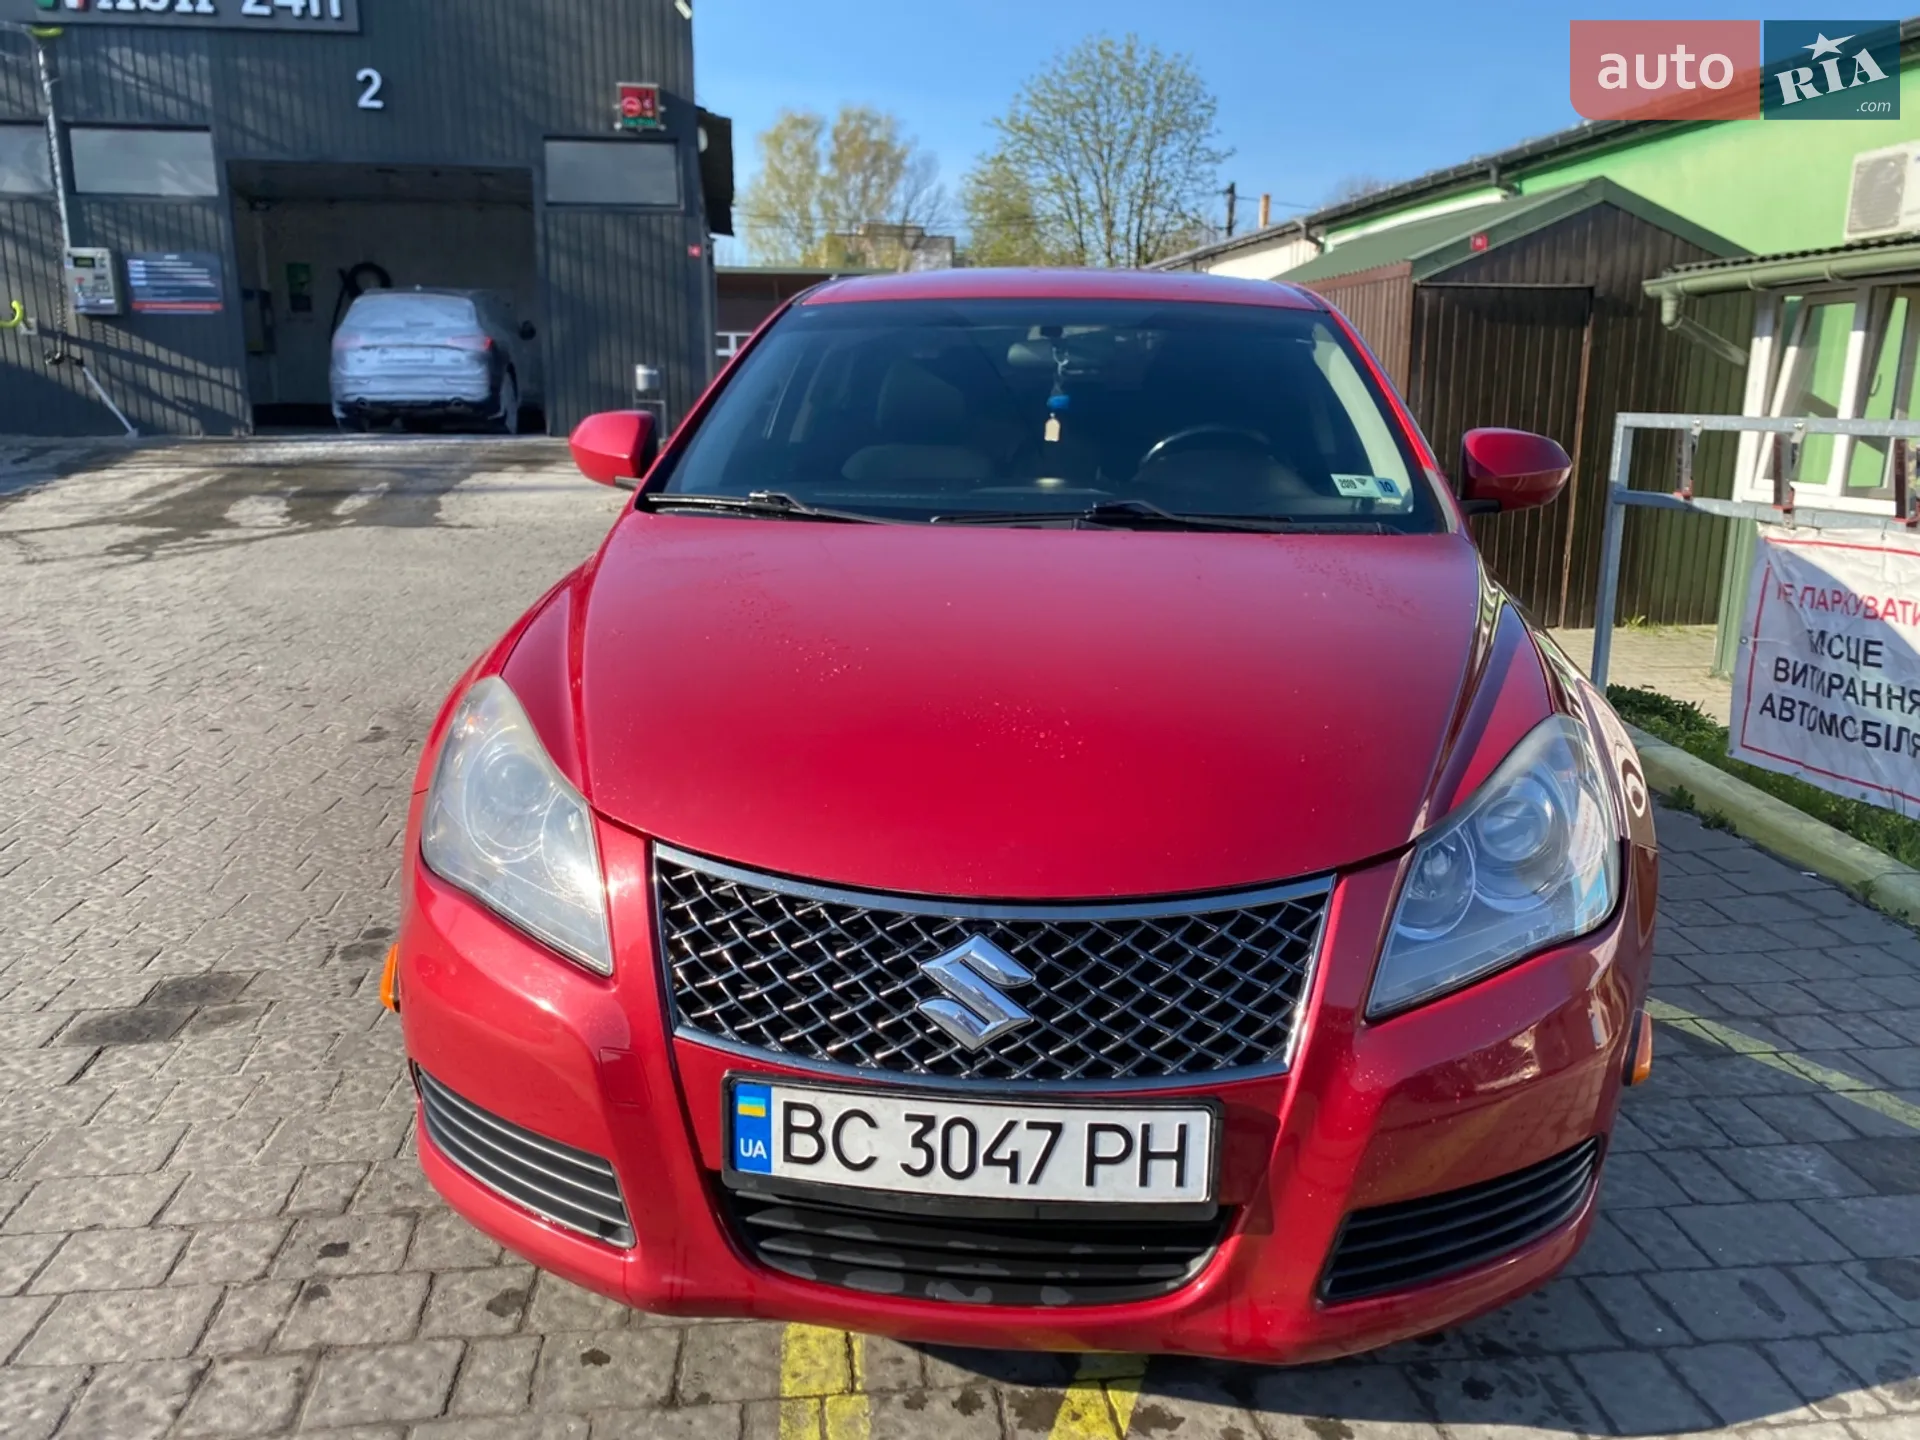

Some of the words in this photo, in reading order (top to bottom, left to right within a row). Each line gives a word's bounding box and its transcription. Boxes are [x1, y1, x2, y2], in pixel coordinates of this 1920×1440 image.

[356, 67, 384, 109] 2
[740, 1137, 767, 1159] UA
[782, 1100, 878, 1172] BC
[900, 1113, 1063, 1185] 3047
[1084, 1122, 1187, 1188] PH
